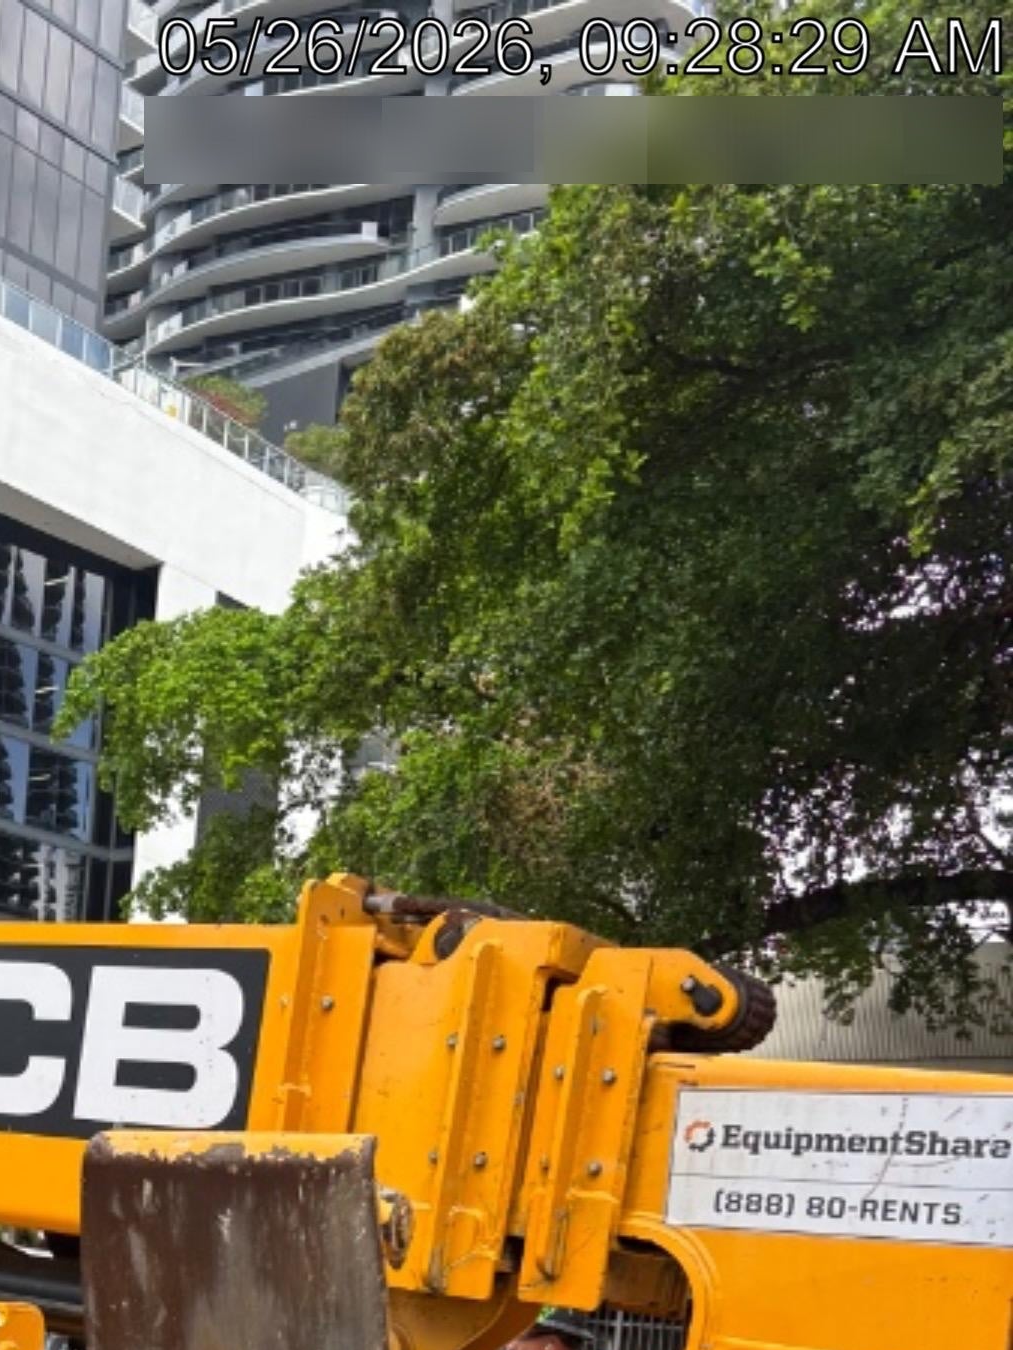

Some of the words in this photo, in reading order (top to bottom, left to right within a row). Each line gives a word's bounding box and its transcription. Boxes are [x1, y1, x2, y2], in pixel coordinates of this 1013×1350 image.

[721, 1124, 1012, 1159] EquipmentShare
[713, 1189, 796, 1218] (888)
[805, 1197, 963, 1227] 80-RENTS
